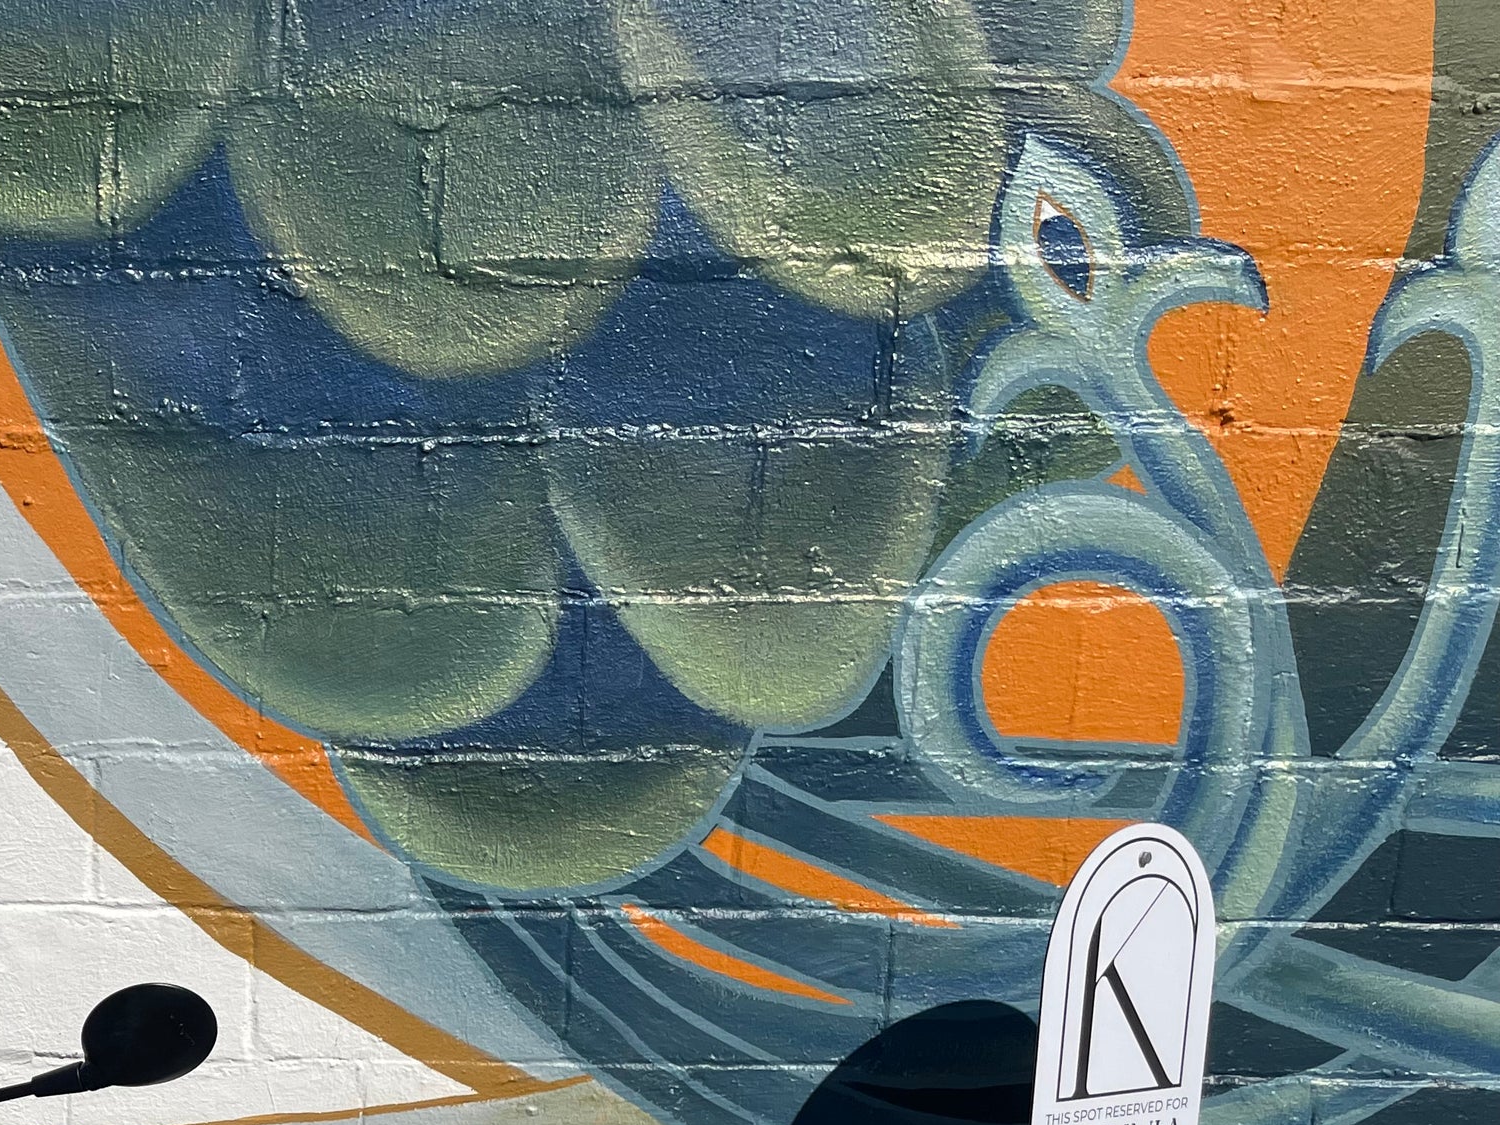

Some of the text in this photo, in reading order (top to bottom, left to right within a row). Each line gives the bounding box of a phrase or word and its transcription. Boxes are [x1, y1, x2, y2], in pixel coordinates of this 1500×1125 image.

[1071, 880, 1174, 1098] K
[1073, 1107, 1103, 1123] SPOT
[1105, 1100, 1163, 1119] RESERVED
[1166, 1097, 1188, 1110] FOR
